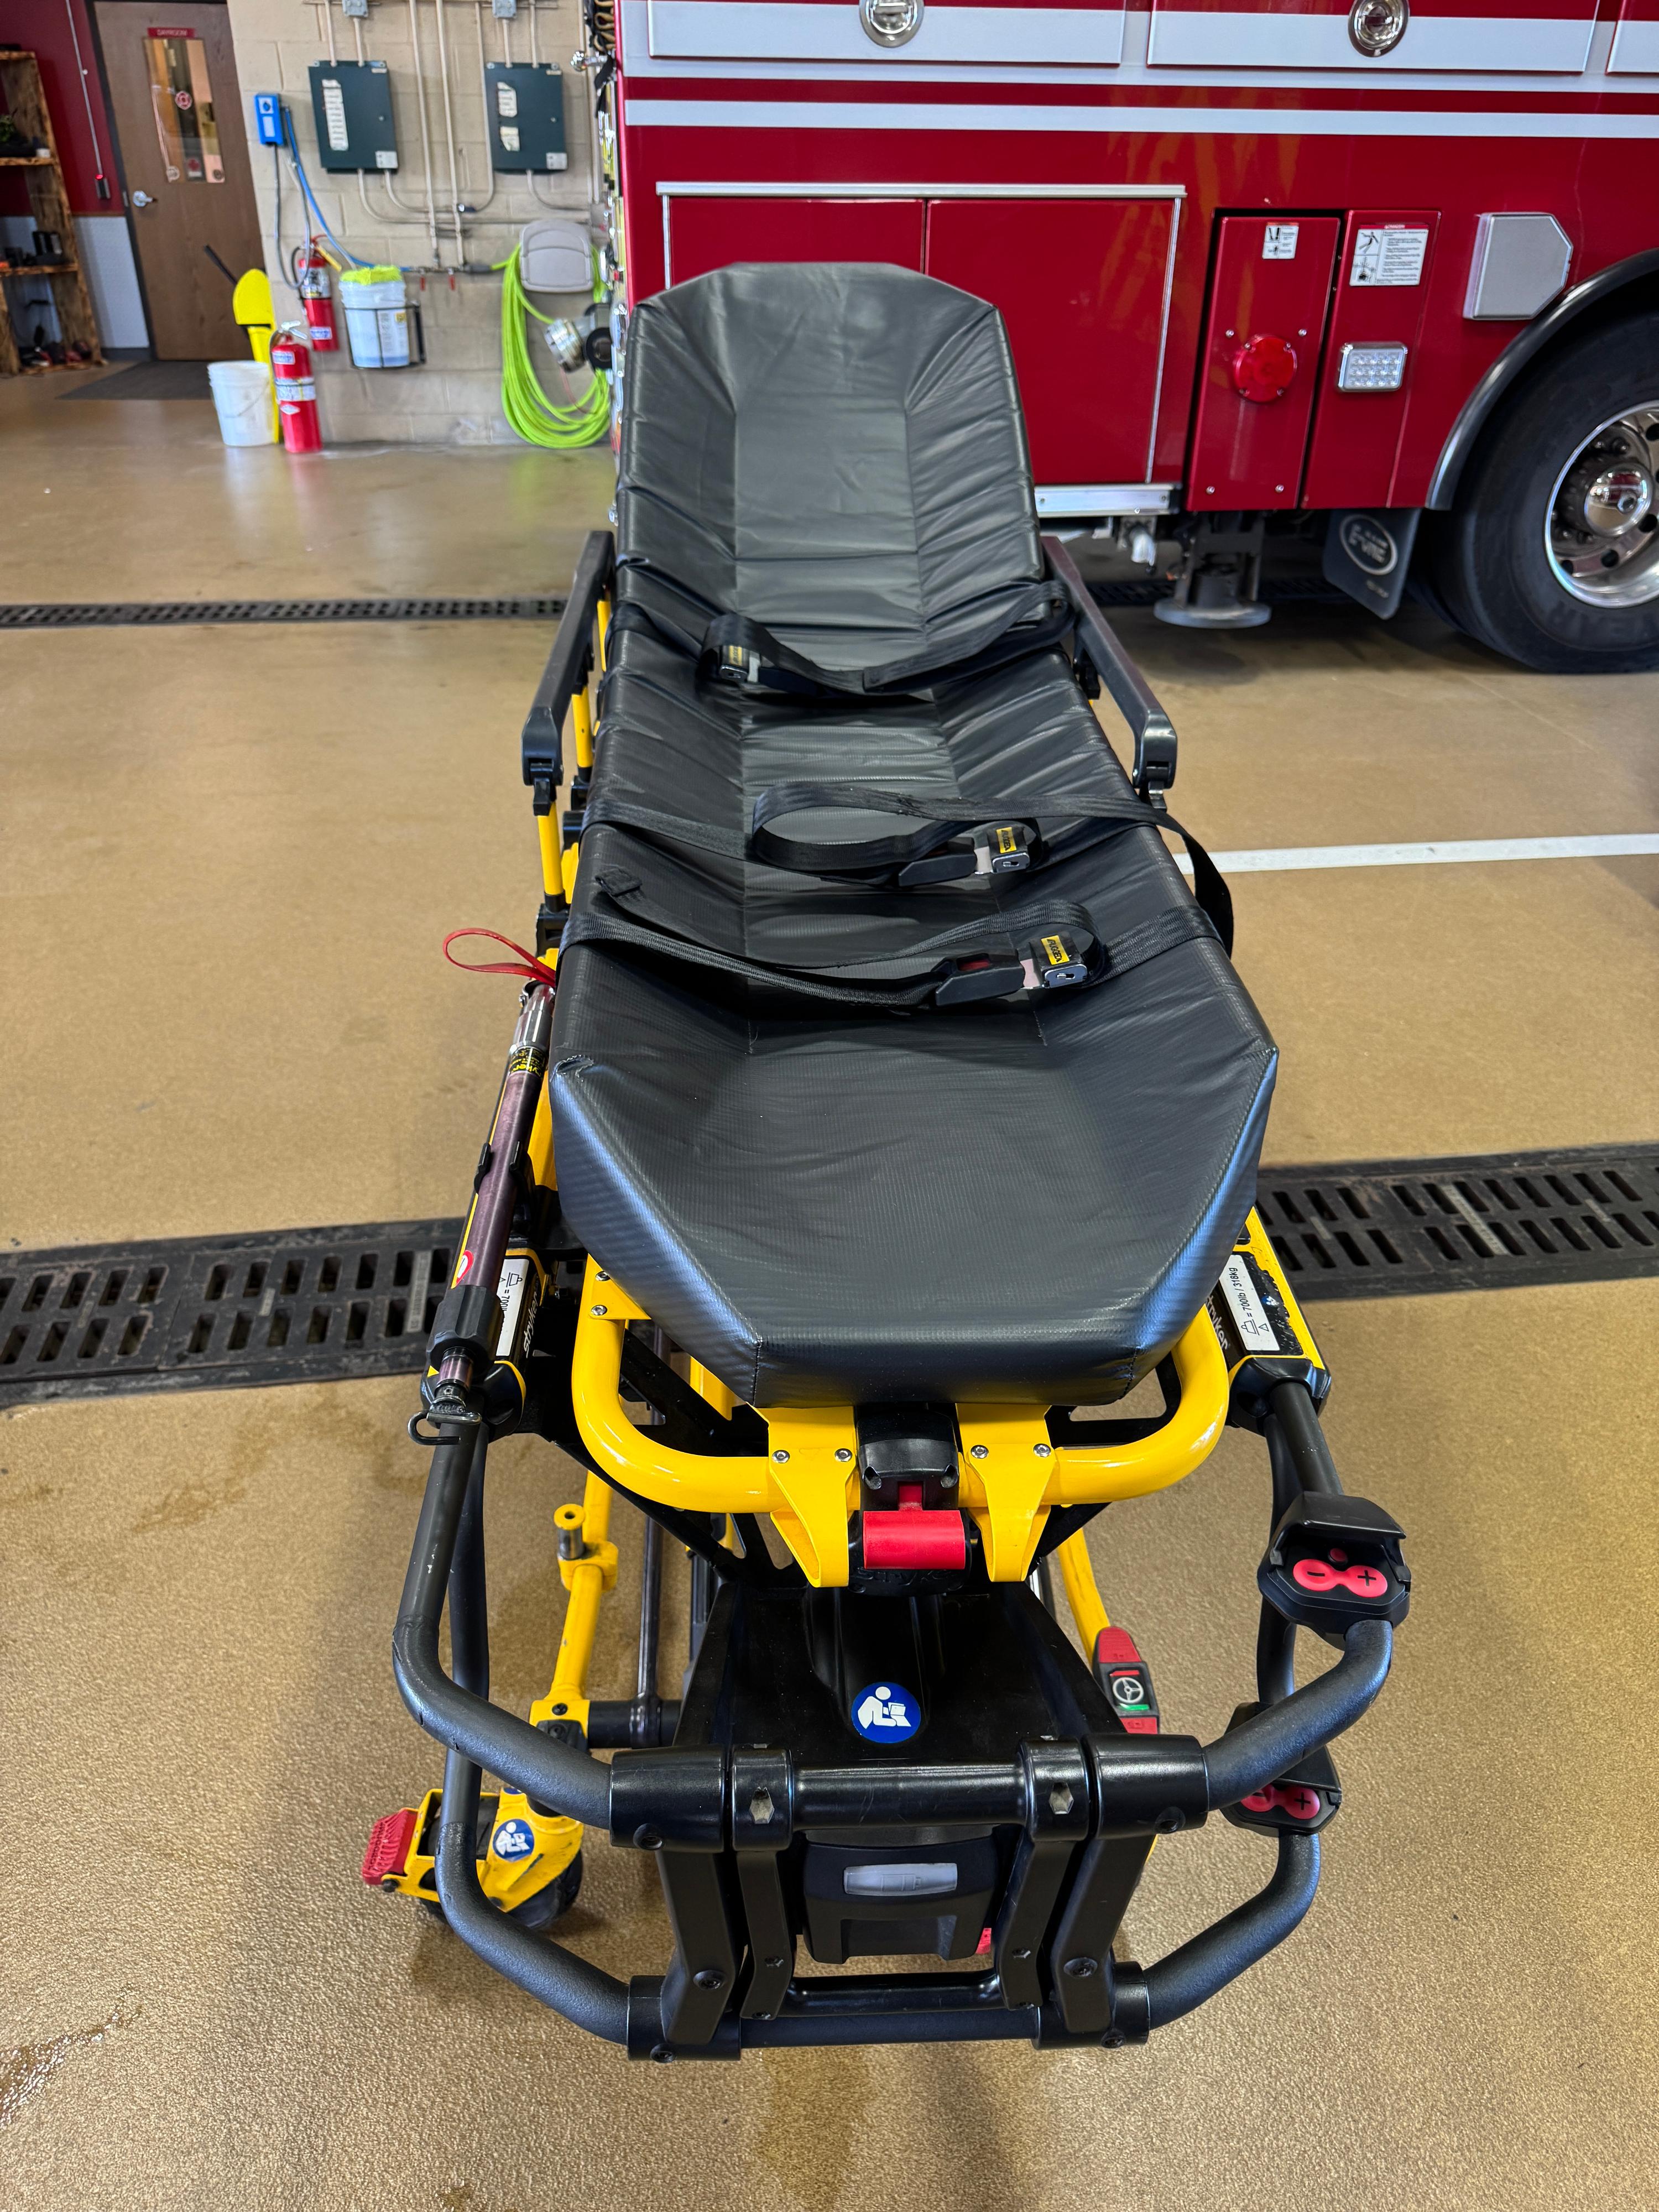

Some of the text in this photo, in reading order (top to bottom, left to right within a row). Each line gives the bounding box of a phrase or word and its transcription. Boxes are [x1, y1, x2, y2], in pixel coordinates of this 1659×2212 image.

[1047, 939, 1062, 962] RUGGED
[1229, 1267, 1242, 1287] 318kg
[1238, 1292, 1252, 1311] 700lb
[523, 1291, 539, 1359] stryker
[1207, 1295, 1228, 1350] tryker
